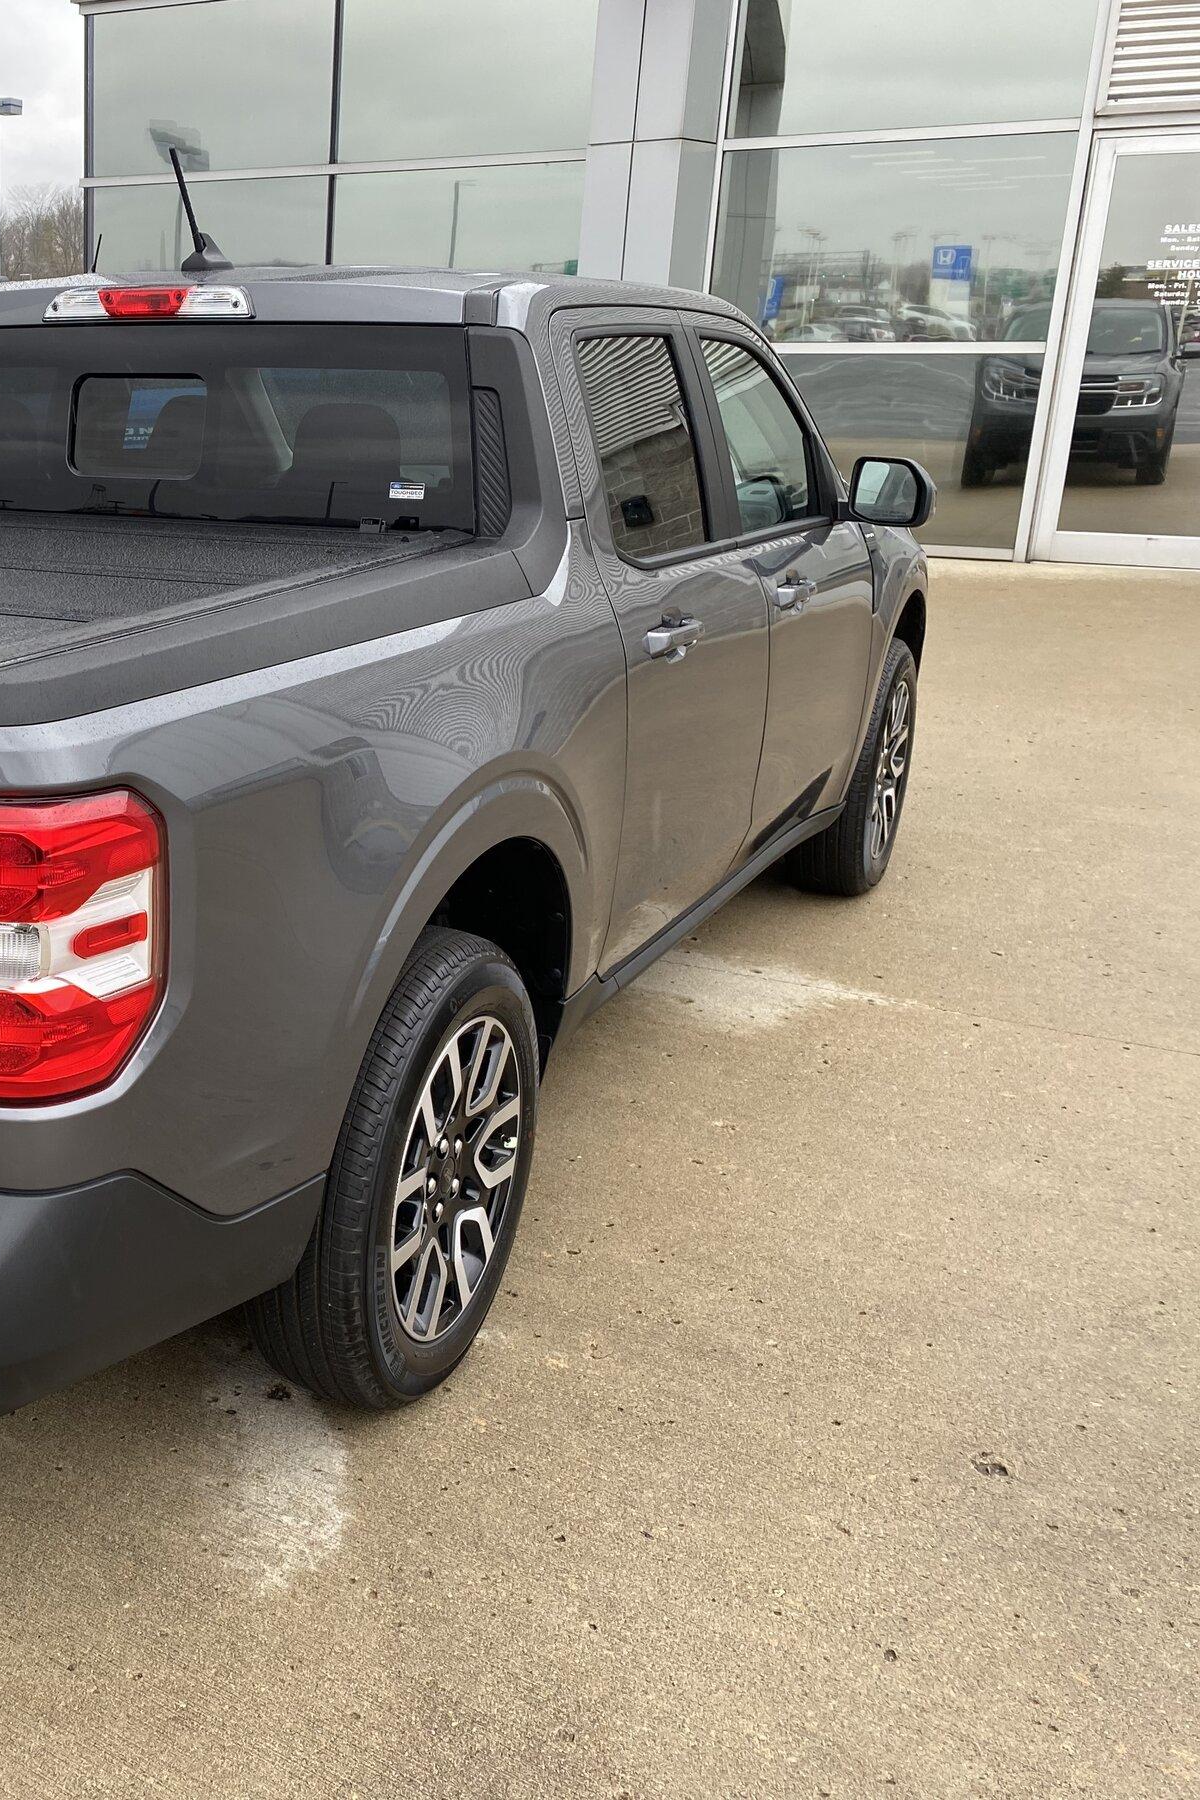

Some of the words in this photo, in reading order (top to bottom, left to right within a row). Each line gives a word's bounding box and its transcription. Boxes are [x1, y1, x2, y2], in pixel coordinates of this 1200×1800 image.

[1146, 260, 1200, 270] SERVICE
[1147, 282, 1167, 290] Mon.
[1153, 290, 1190, 298] Saturday
[375, 1251, 396, 1355] MICHELIN
